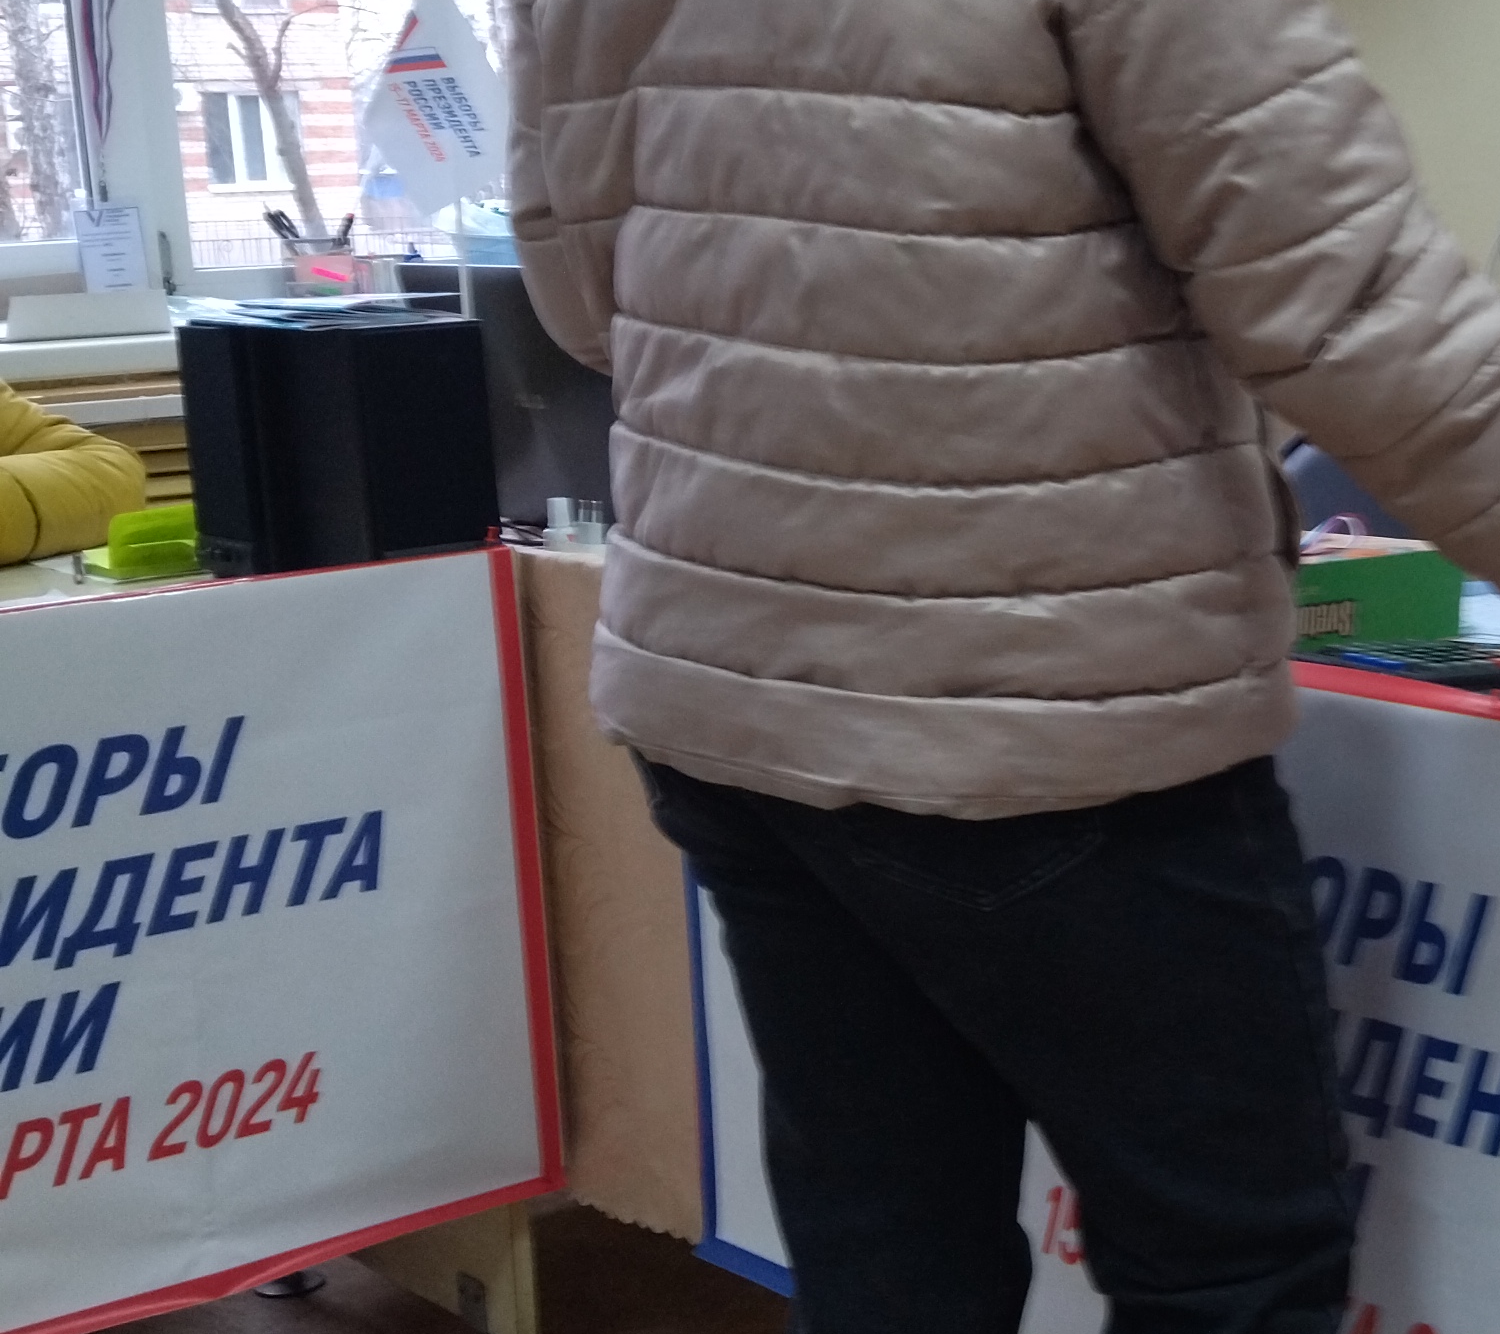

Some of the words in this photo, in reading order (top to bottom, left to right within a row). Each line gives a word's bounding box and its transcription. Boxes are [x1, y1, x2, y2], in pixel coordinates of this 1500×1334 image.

[402, 80, 446, 130] РОССИИ
[421, 78, 481, 158] ПРЕЗИДЕНТА
[440, 77, 486, 131] ВЫБОРЫ
[0, 715, 245, 839] ОРЫ
[147, 1051, 321, 1162] 2024
